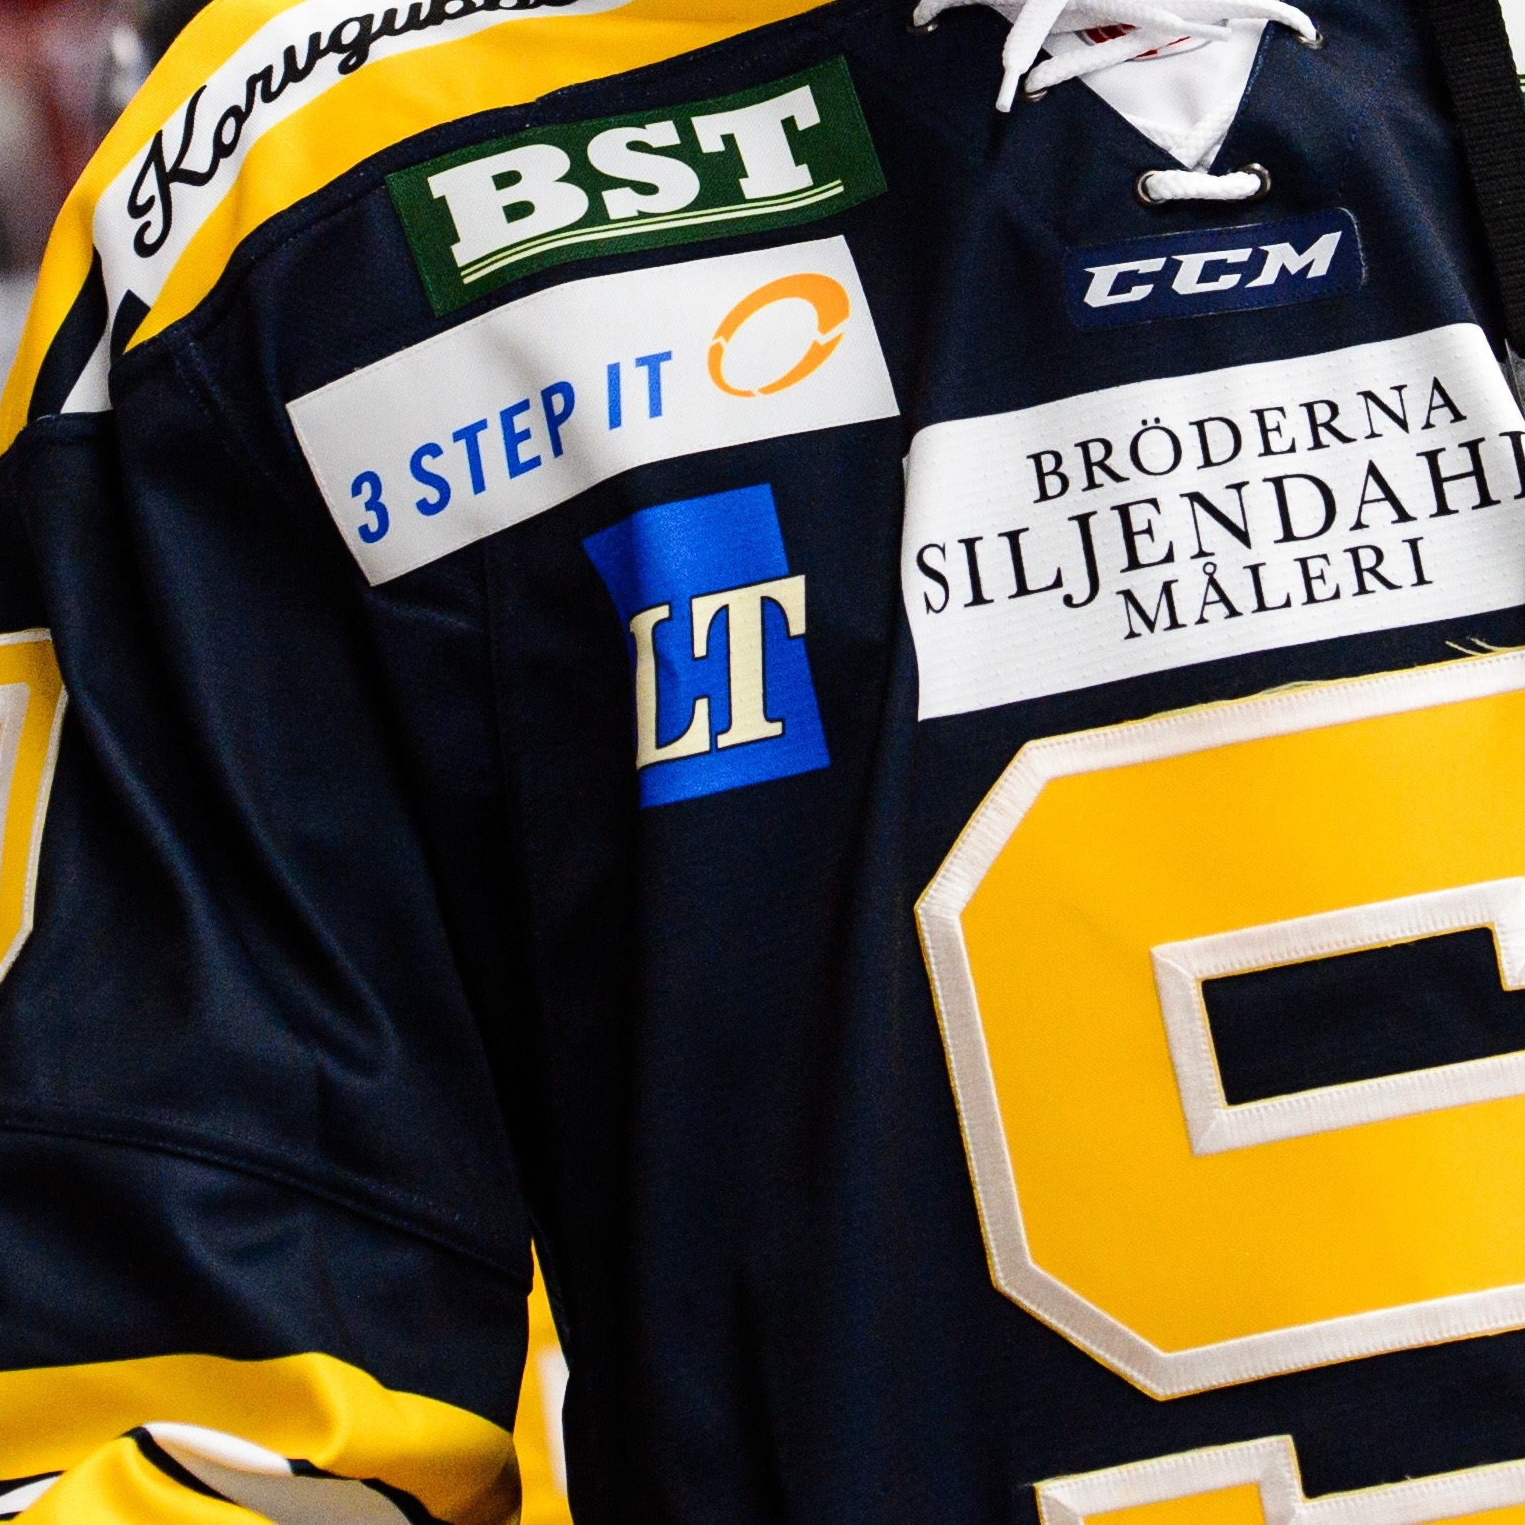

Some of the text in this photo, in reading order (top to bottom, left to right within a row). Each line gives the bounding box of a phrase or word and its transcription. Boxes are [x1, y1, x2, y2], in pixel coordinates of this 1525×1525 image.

[429, 85, 821, 268] BST
[1081, 230, 1343, 310] CCM
[350, 349, 674, 545] 3 STEP IT
[1026, 376, 1467, 505] BRÖDERNA
[1115, 537, 1434, 642] MÅLERI
[629, 573, 806, 769] LT
